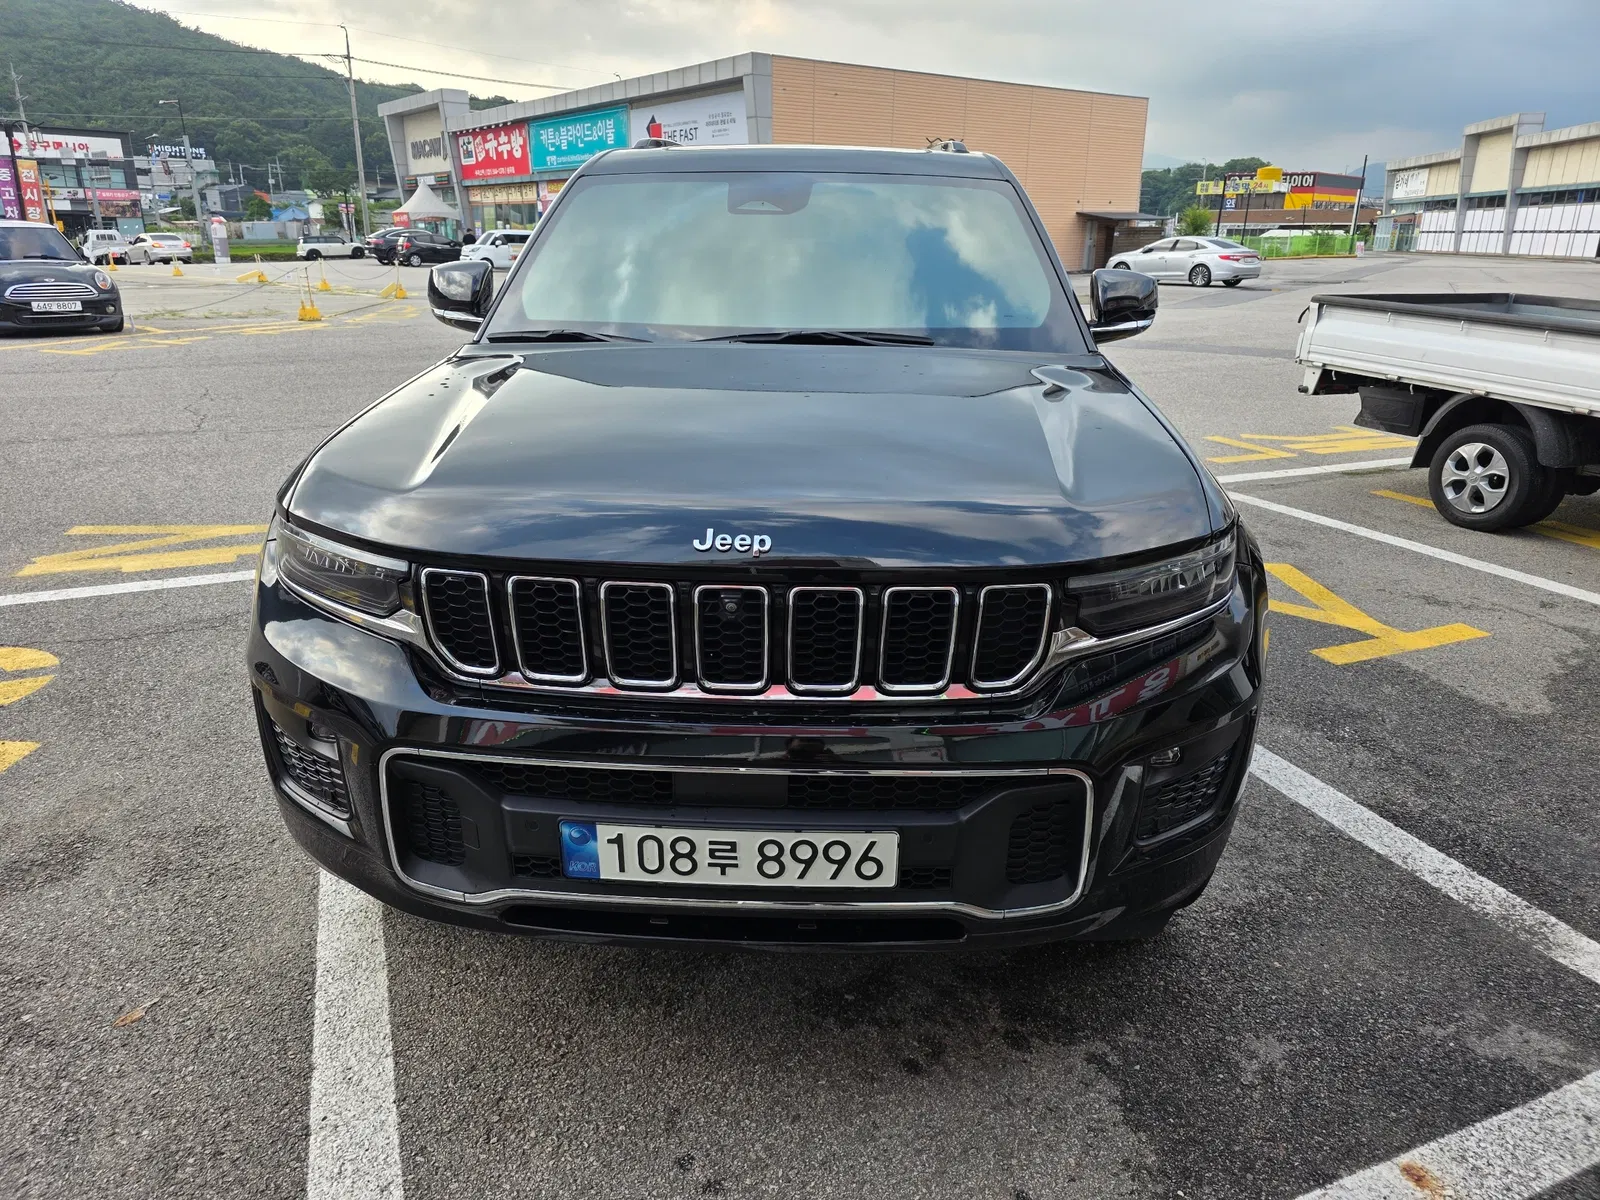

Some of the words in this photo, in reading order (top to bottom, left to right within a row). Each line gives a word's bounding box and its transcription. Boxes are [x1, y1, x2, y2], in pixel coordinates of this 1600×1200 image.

[153, 144, 206, 154] HIGHTNE
[540, 118, 616, 151] 커튼&블라인드&이불
[663, 130, 677, 142] THE
[680, 127, 698, 142] FAST
[0, 168, 19, 219] 중고차
[21, 169, 41, 219] 전시장
[56, 302, 77, 310] 8807
[693, 528, 772, 557] Jeep
[606, 832, 739, 877] 108루
[756, 838, 885, 882] 8996
